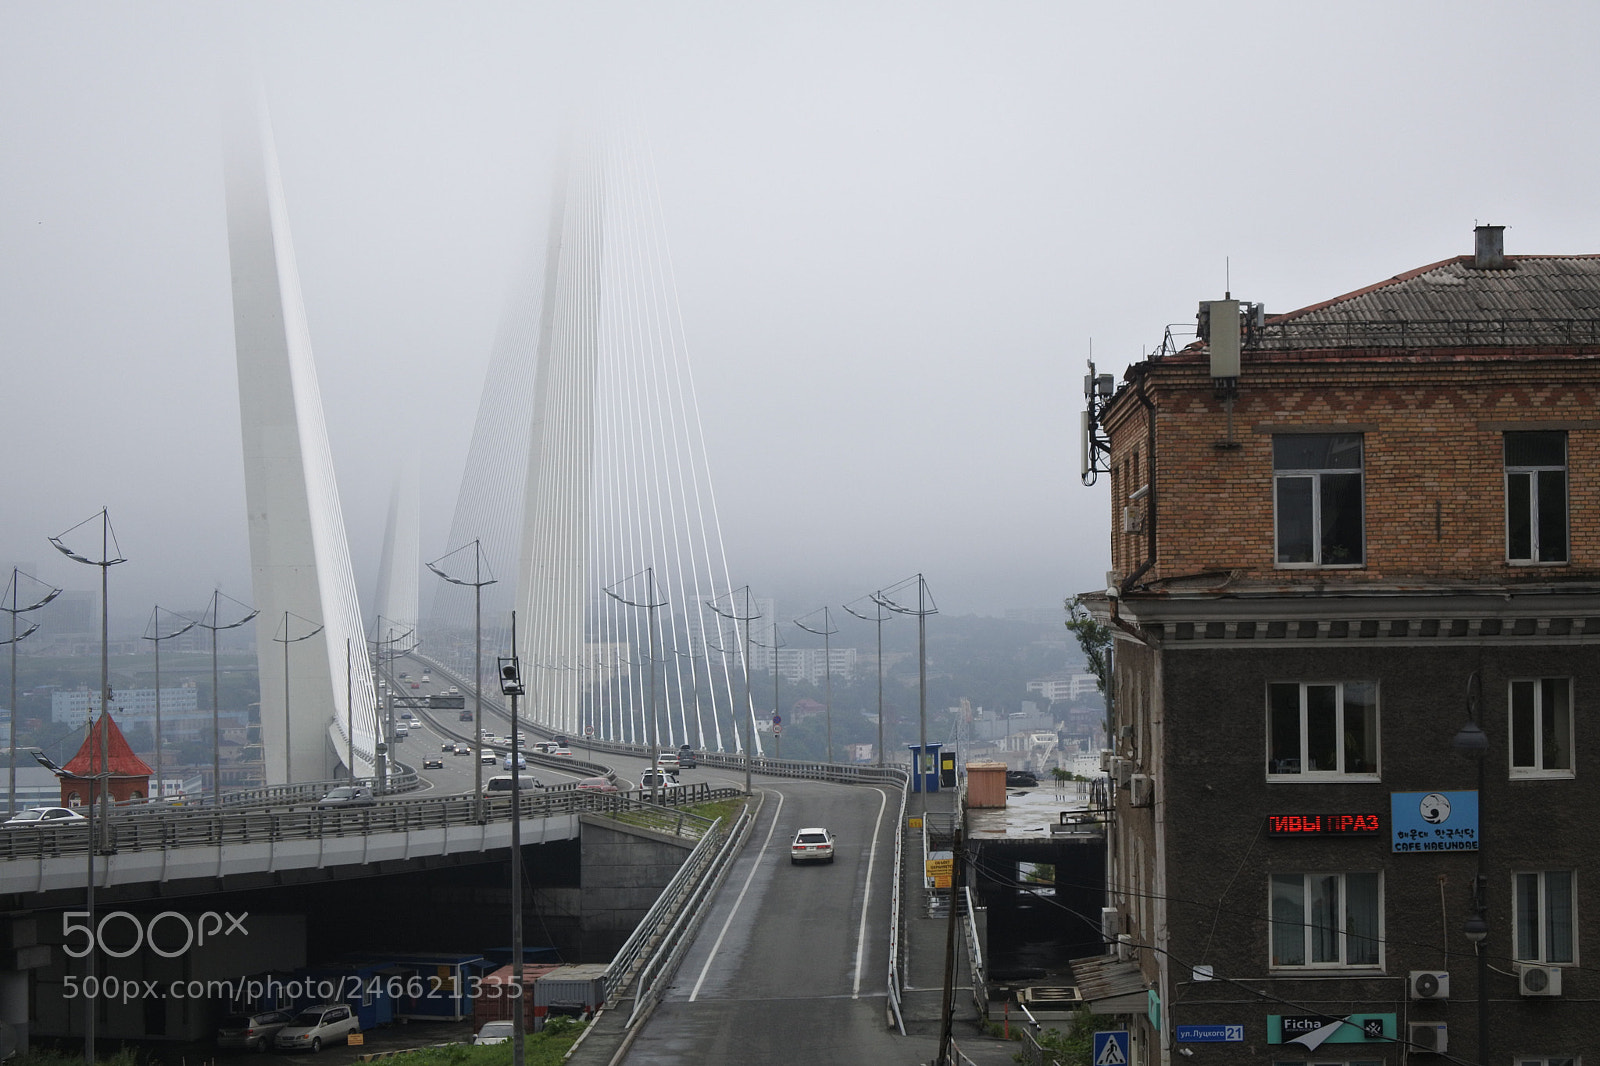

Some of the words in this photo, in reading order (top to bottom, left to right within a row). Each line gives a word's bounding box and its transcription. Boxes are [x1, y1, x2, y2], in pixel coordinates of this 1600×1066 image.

[1394, 842, 1421, 851] CAFE
[1423, 841, 1478, 851] HAEUNDAE
[1284, 1018, 1322, 1029] Ficha
[1226, 1027, 1241, 1039] 21
